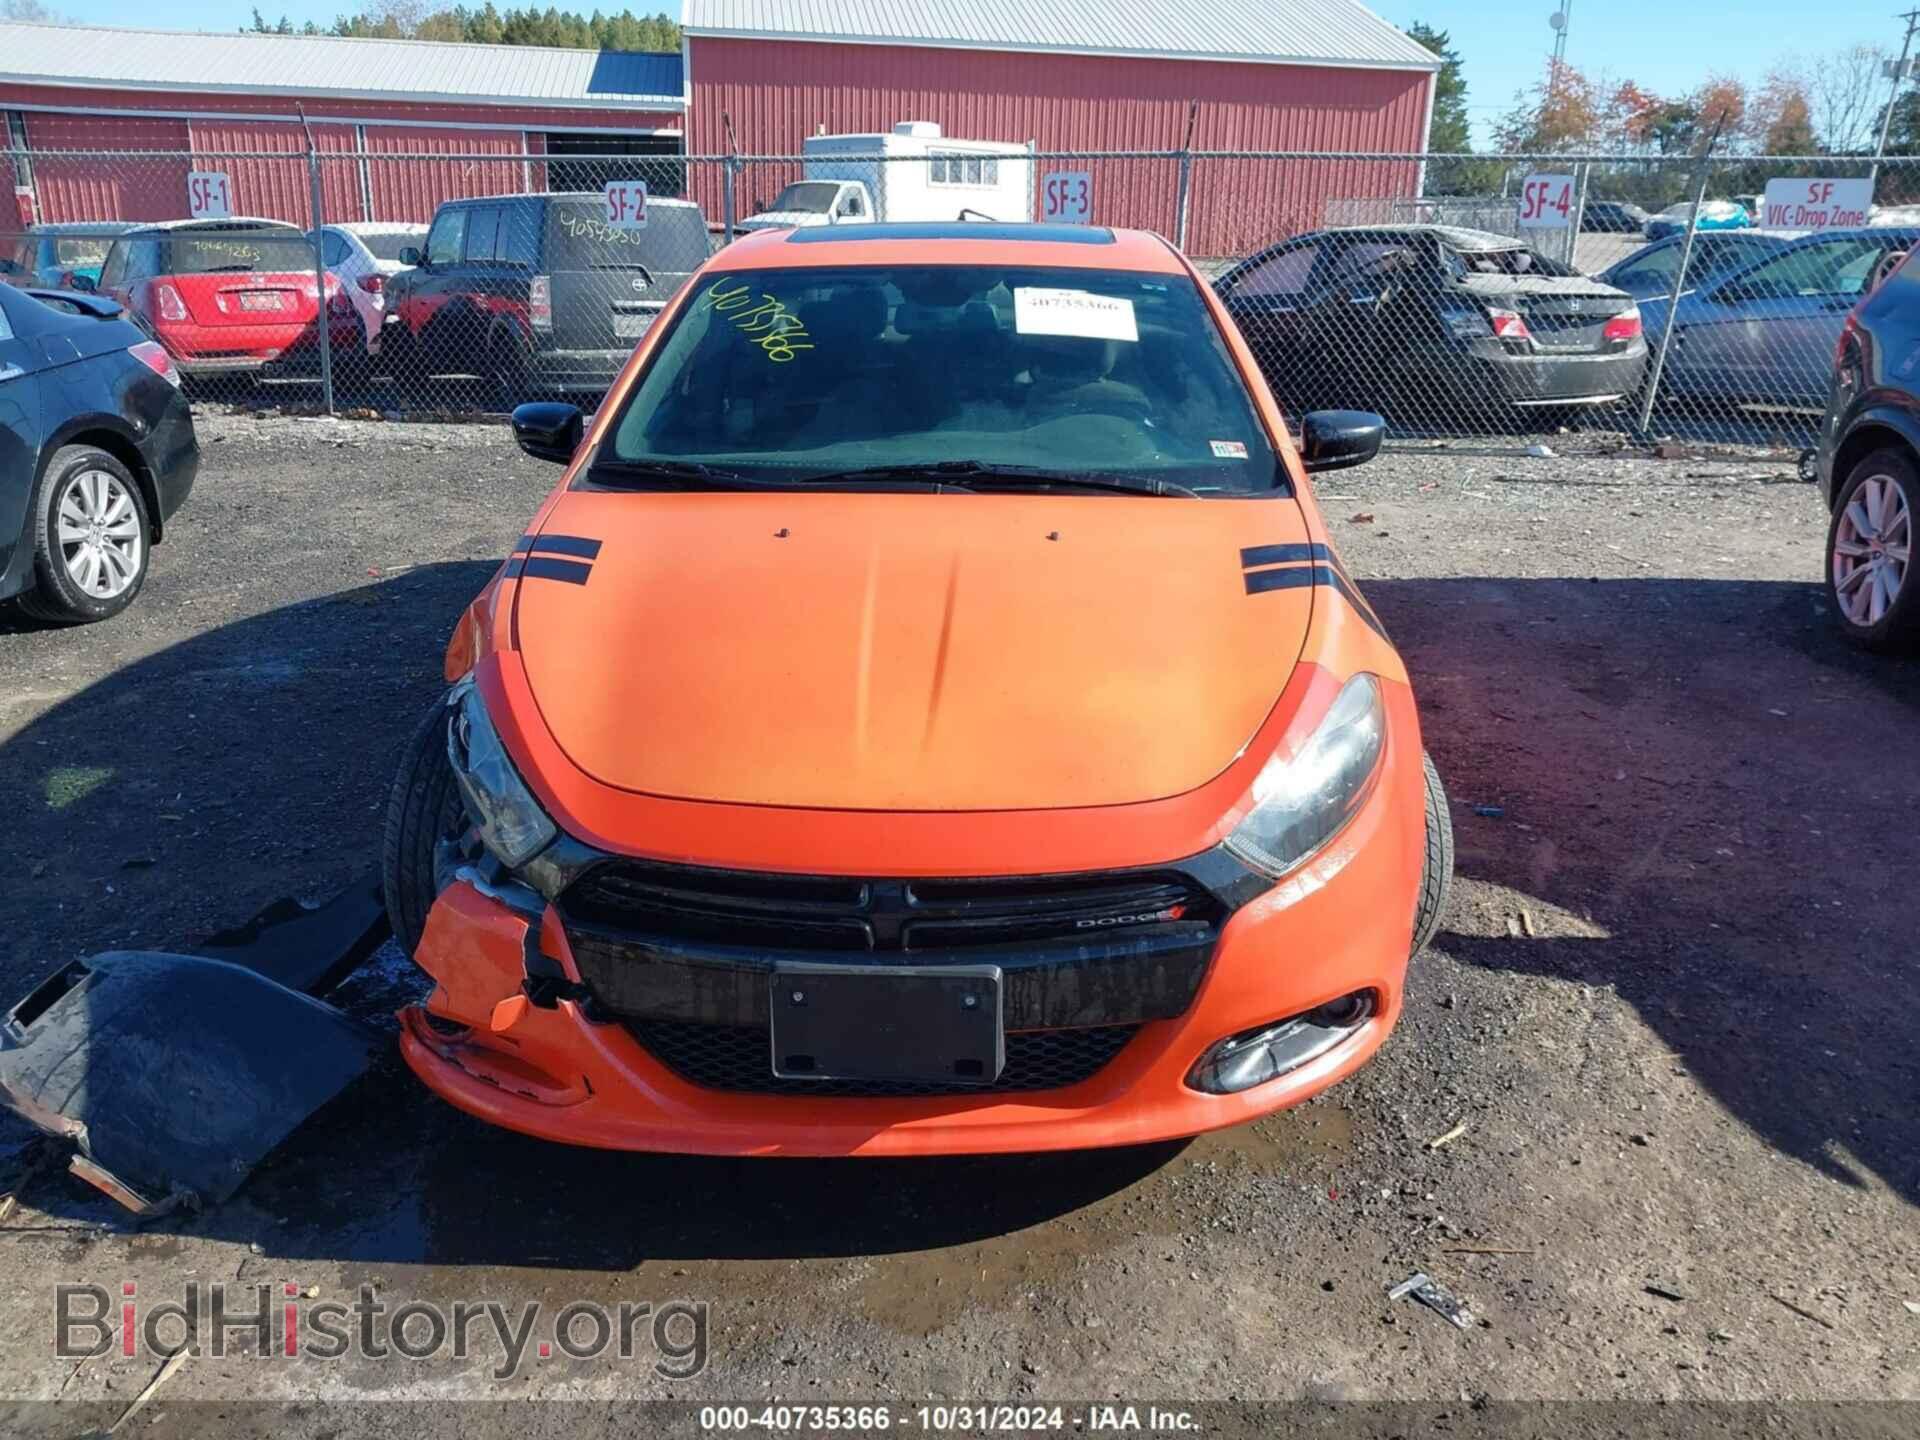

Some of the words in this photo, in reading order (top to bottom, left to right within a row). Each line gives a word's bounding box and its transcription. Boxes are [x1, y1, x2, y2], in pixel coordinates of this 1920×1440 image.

[192, 178, 229, 211] SF-1
[608, 188, 645, 221] SF-2
[1047, 179, 1089, 215] SF-3
[1522, 182, 1570, 218] SF-4
[1808, 182, 1835, 203] SF
[1768, 204, 1829, 228] VIC-Drop
[1830, 205, 1865, 226] Zone
